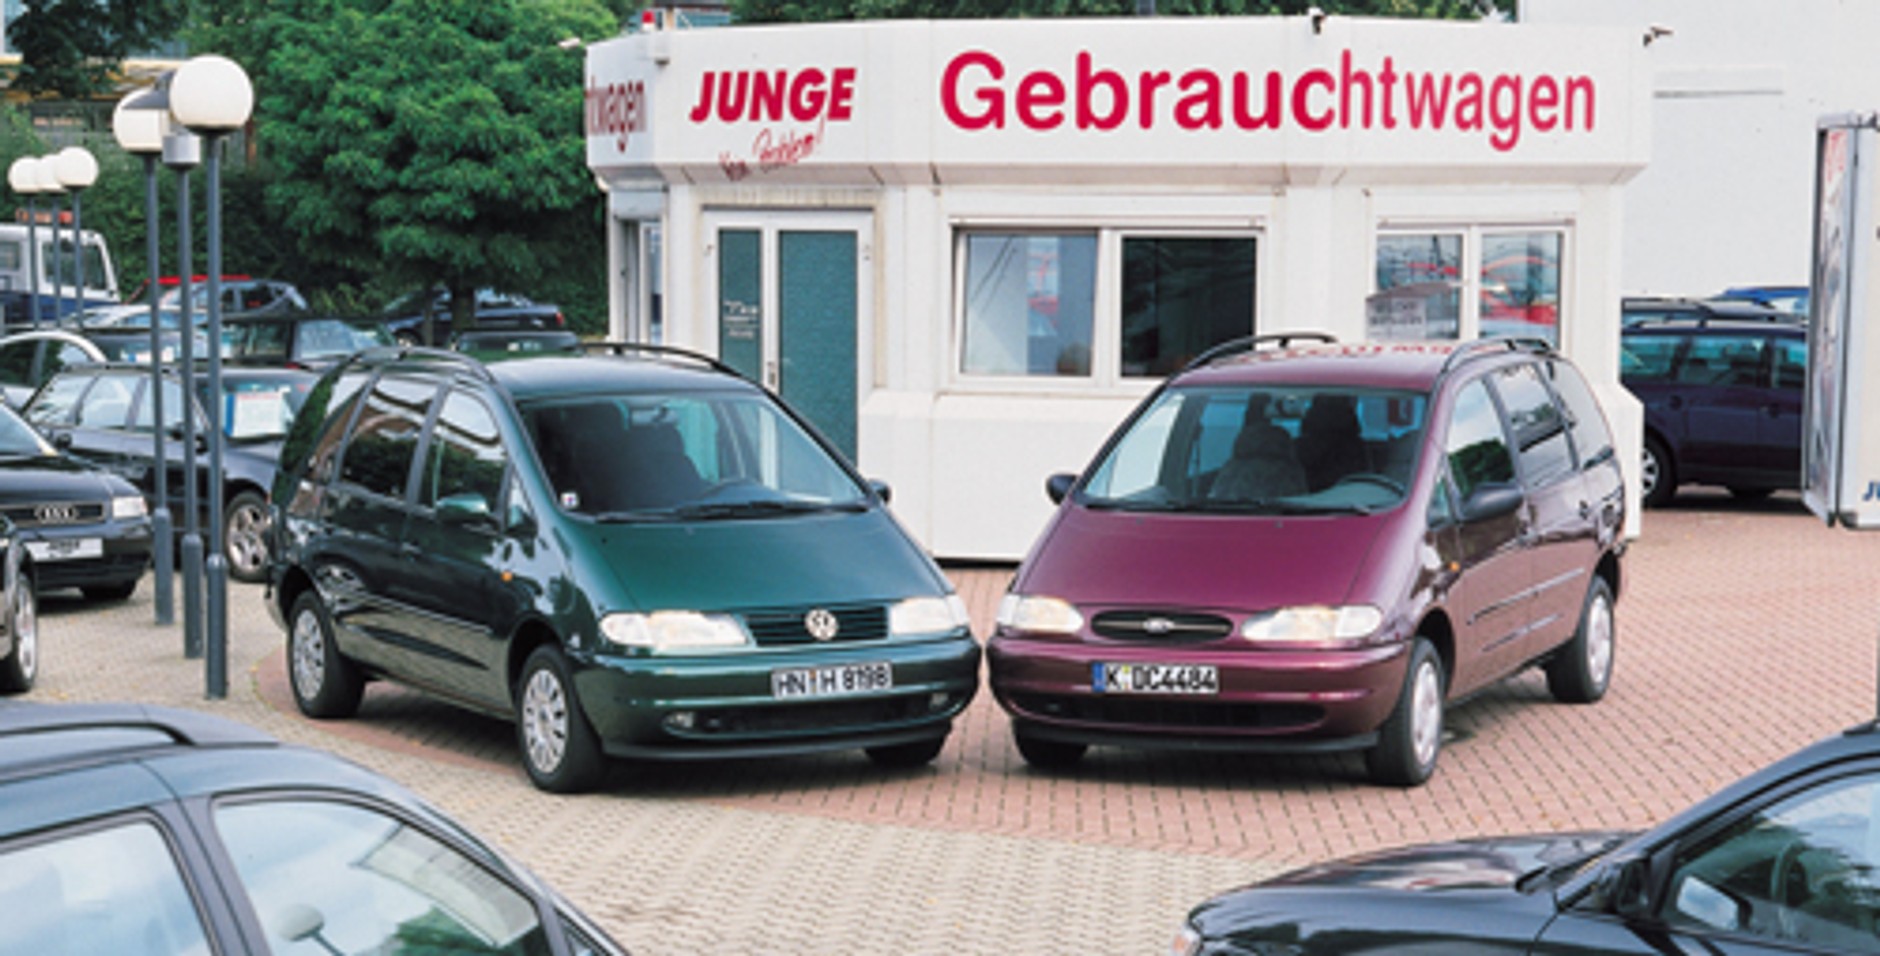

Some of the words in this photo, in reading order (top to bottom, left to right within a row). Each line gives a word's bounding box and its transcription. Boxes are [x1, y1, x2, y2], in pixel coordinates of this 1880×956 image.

[690, 67, 856, 122] JUNGE
[940, 49, 1596, 152] Gebrauchtwagen
[778, 672, 806, 695] HN
[820, 669, 837, 691] H
[1106, 664, 1121, 689] K
